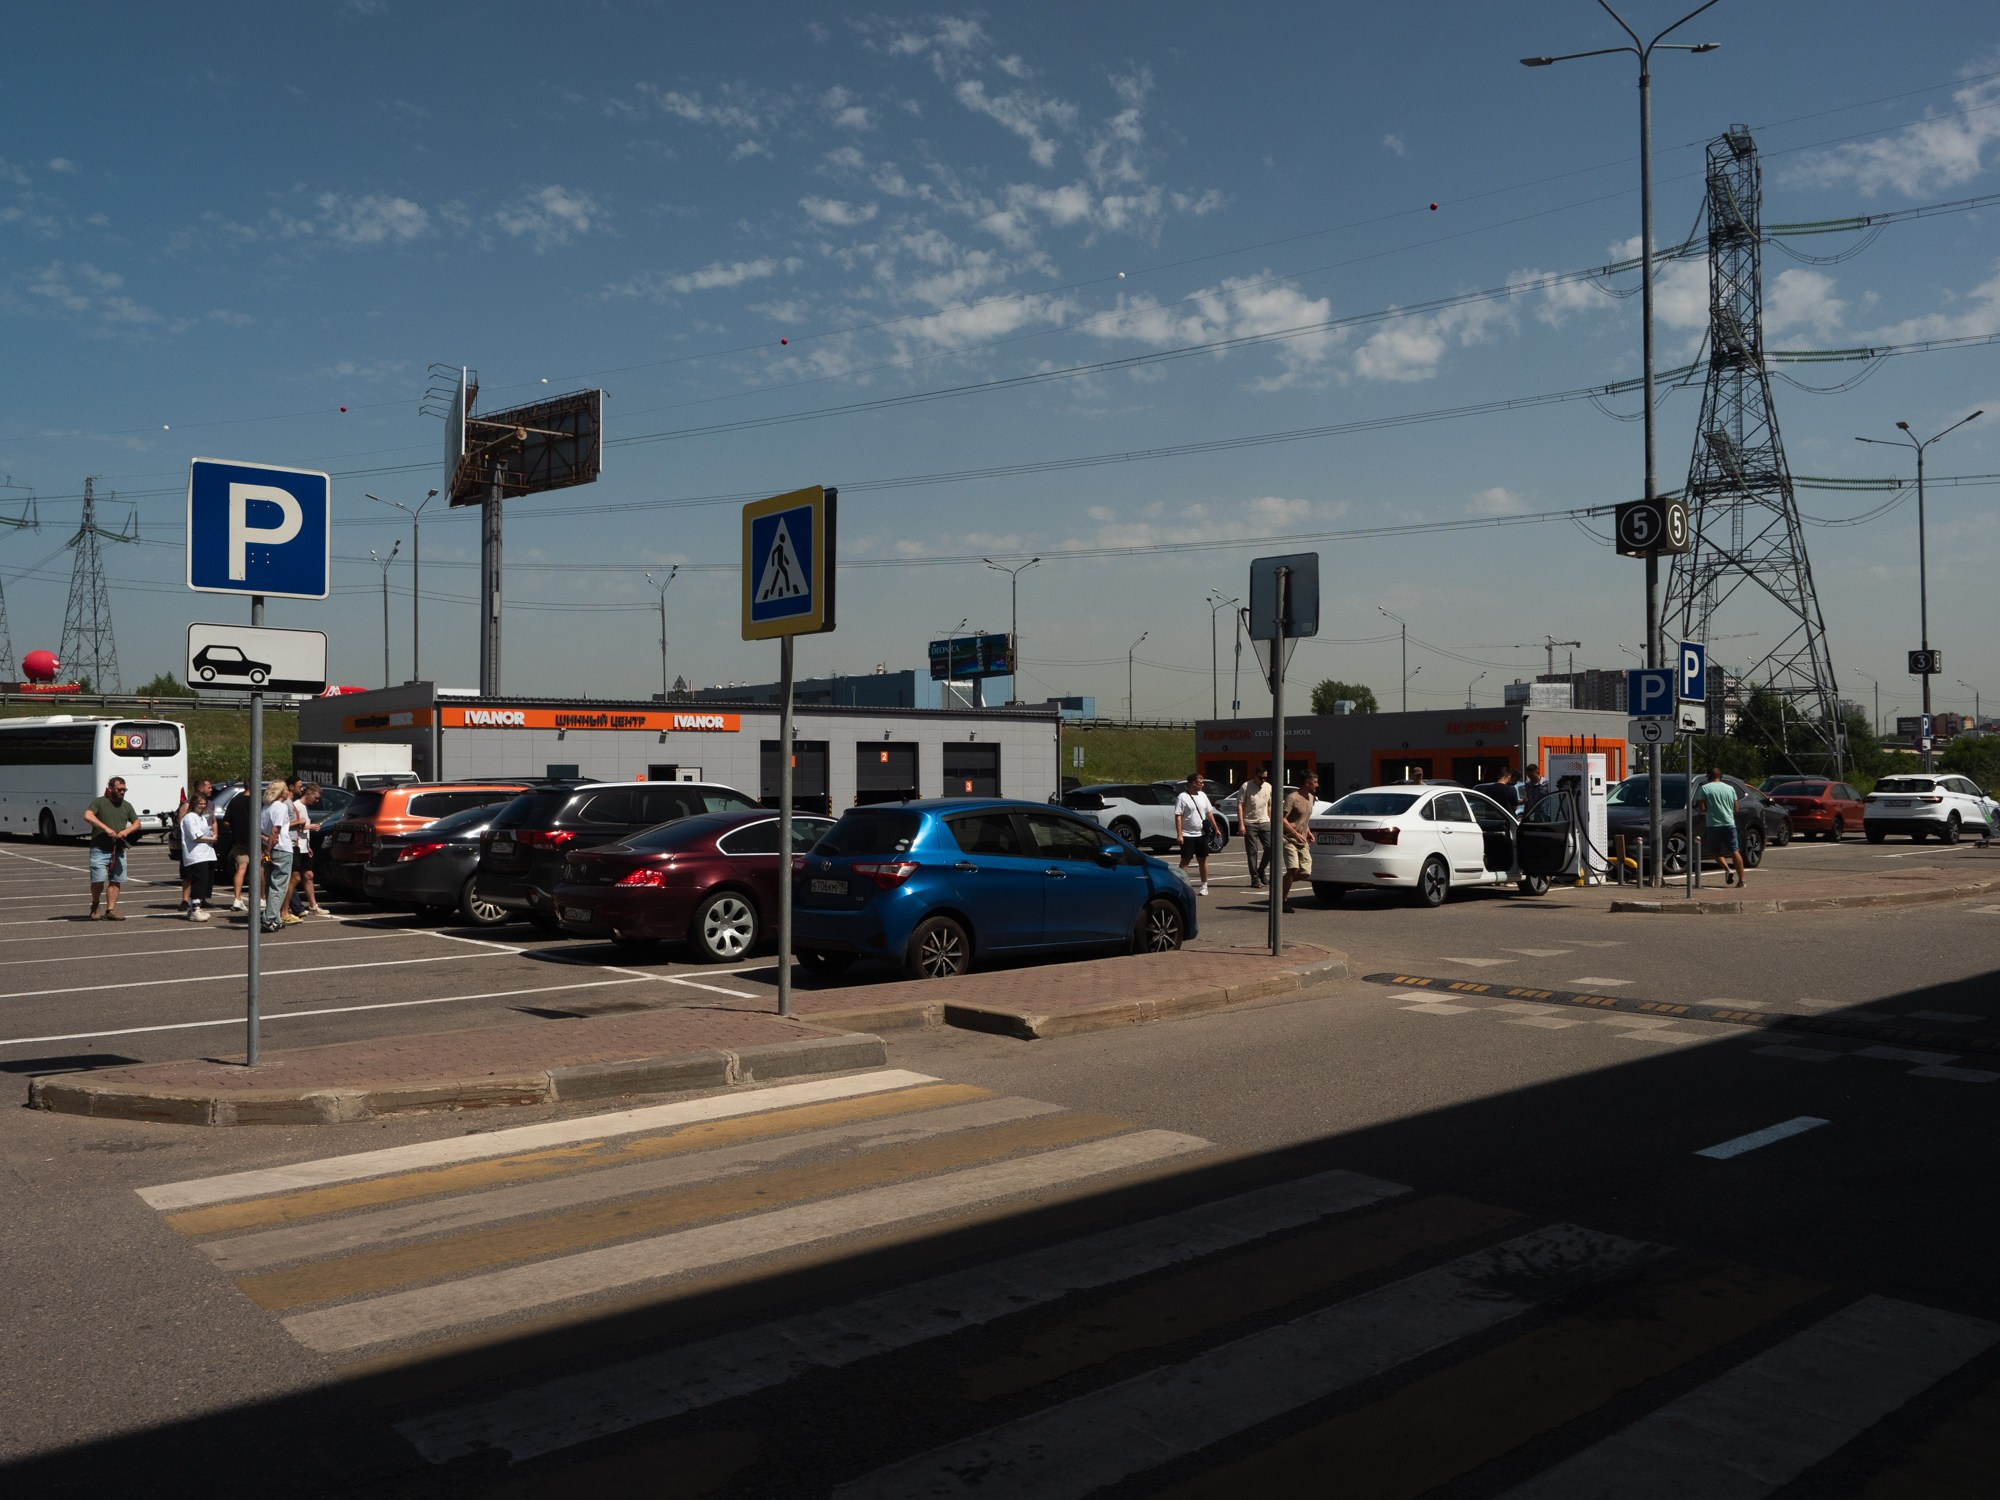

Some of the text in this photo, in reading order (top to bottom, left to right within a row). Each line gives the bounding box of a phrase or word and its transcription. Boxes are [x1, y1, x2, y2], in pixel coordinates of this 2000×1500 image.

[228, 482, 303, 581] P
[1633, 512, 1649, 539] 5
[1674, 510, 1682, 541] 5
[931, 645, 960, 655] DEONCA
[1917, 655, 1925, 668] 3
[1684, 650, 1699, 694] P
[1640, 674, 1666, 710] P
[464, 710, 525, 726] IVANOR
[555, 713, 646, 729] ШИННЫЙ ЦЕНТР
[673, 715, 724, 730] IVANOR
[1923, 718, 1929, 735] P
[881, 753, 887, 761] 2
[966, 783, 972, 791] 3
